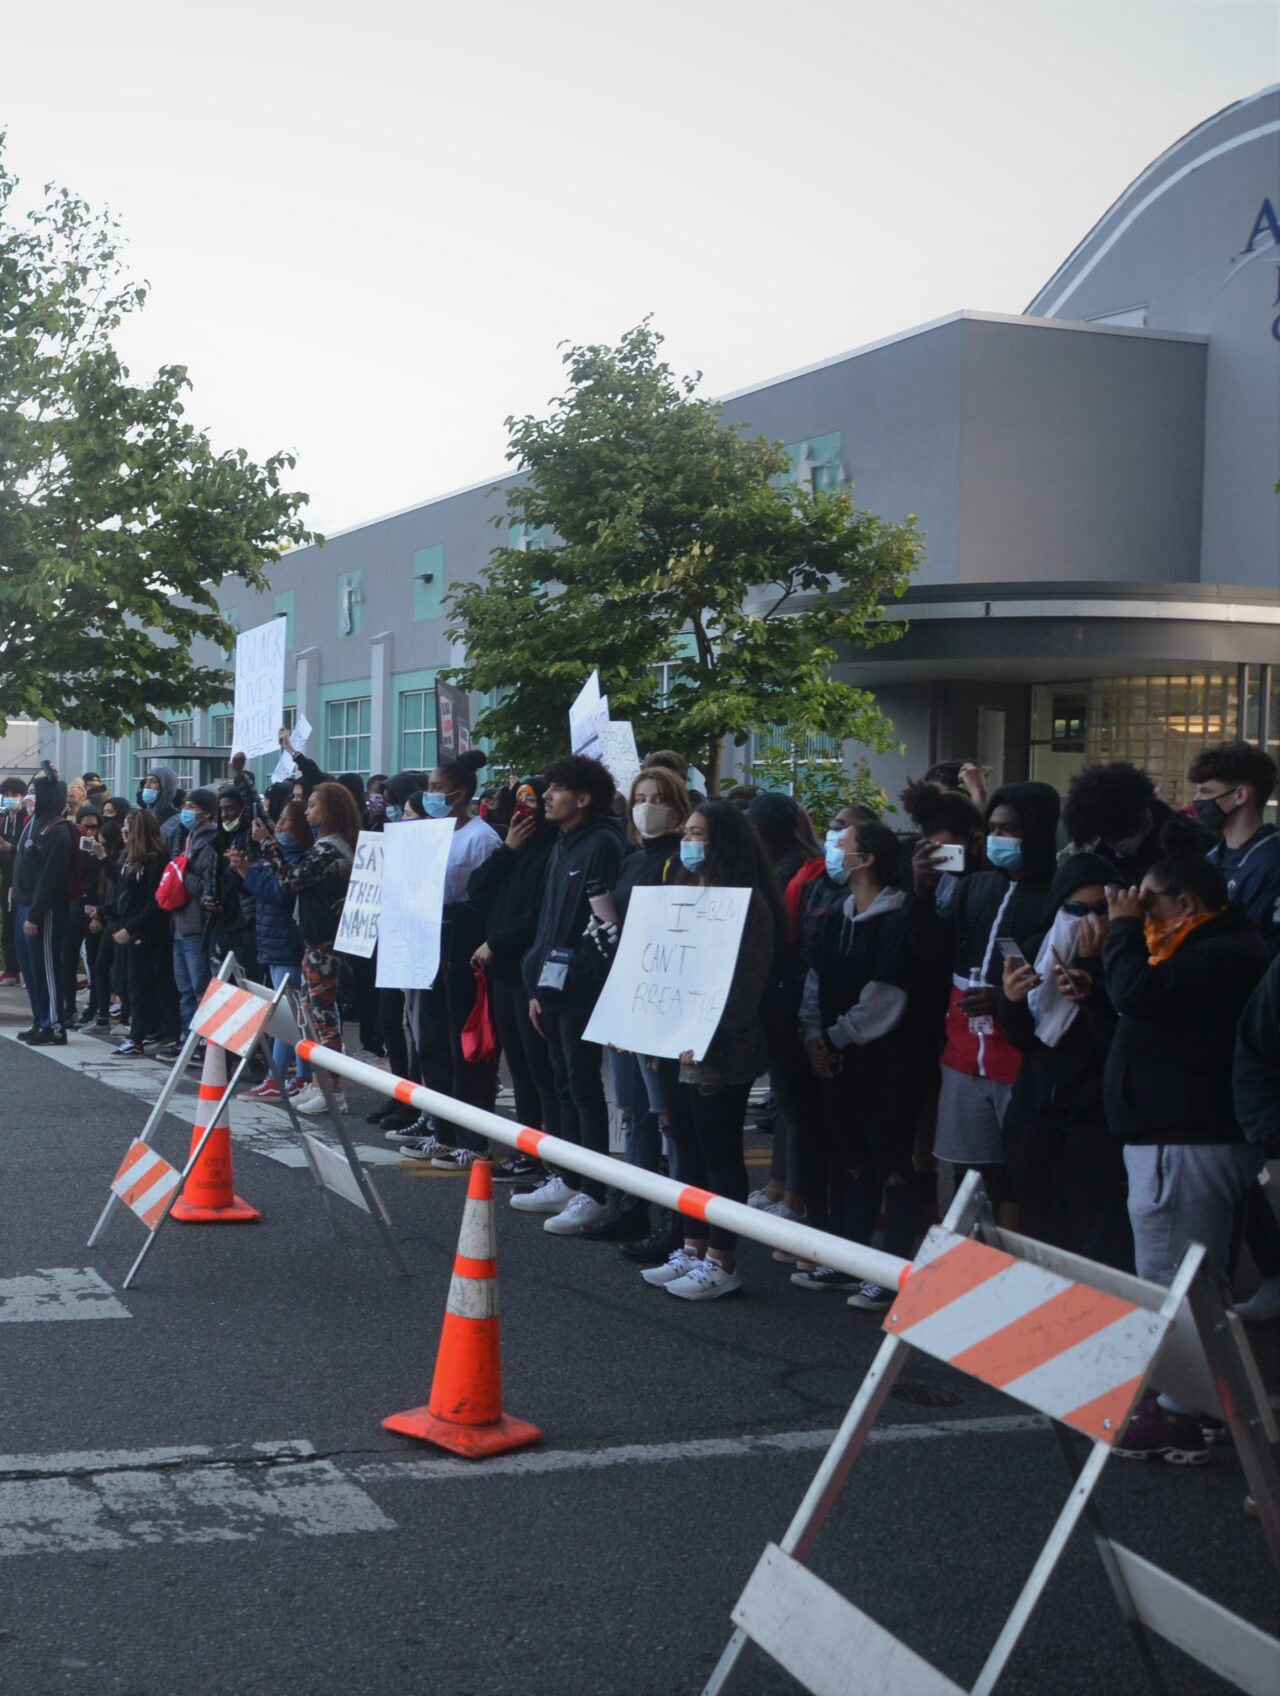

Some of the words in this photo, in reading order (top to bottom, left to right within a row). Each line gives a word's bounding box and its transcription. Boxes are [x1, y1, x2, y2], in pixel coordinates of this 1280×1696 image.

[239, 625, 284, 678] BLACK
[237, 675, 277, 712] LIVES
[235, 704, 276, 746] MATTER
[668, 902, 697, 933] I
[641, 942, 697, 977] CAN'T
[631, 981, 721, 1024] BREATHE
